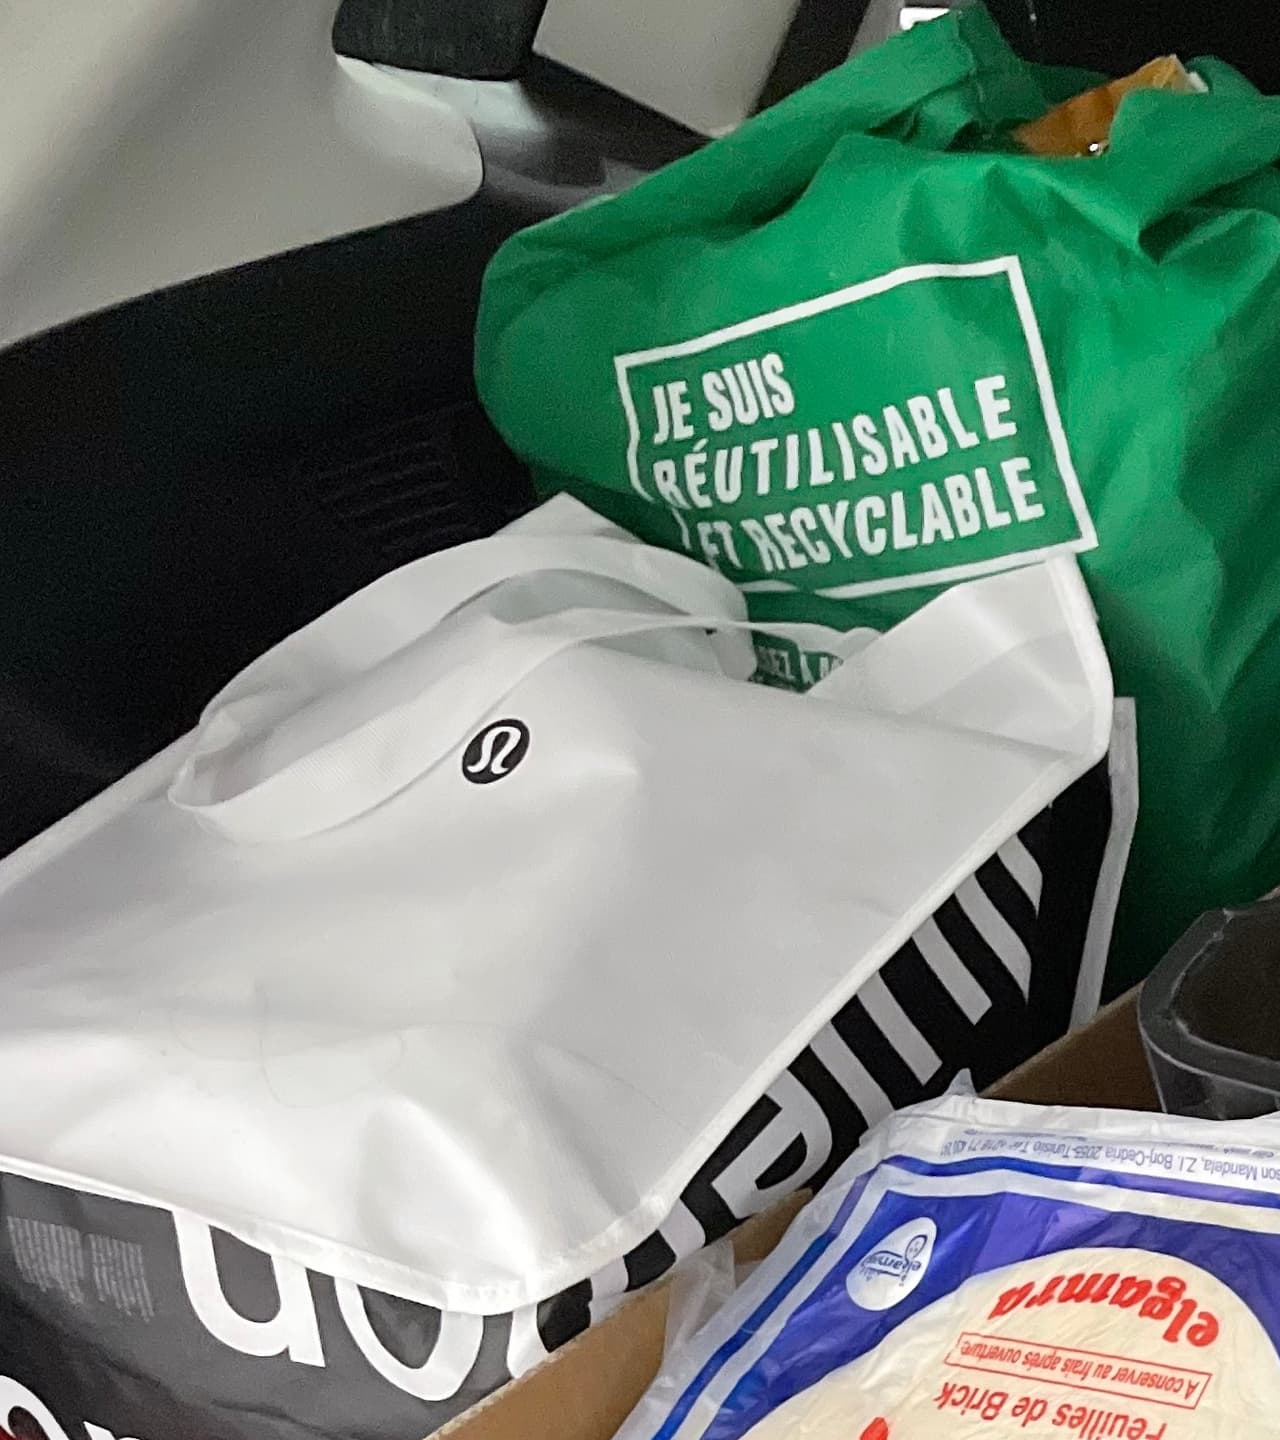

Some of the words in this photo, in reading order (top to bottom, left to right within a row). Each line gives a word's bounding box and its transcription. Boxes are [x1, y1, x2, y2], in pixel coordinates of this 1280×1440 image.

[653, 381, 694, 444] JE
[702, 353, 796, 431] SUIS
[653, 375, 1016, 511] RÉUTILISABLE
[697, 517, 743, 568] ET
[745, 456, 1045, 572] RECYCLABLE
[1202, 1157, 1259, 1181] Mandela,
[992, 1268, 1221, 1350] elgamra
[1058, 1355, 1089, 1381] frais
[1090, 1362, 1110, 1381] au
[1111, 1363, 1182, 1397] conserver
[935, 1381, 1004, 1421] Brick
[1011, 1396, 1044, 1429] de
